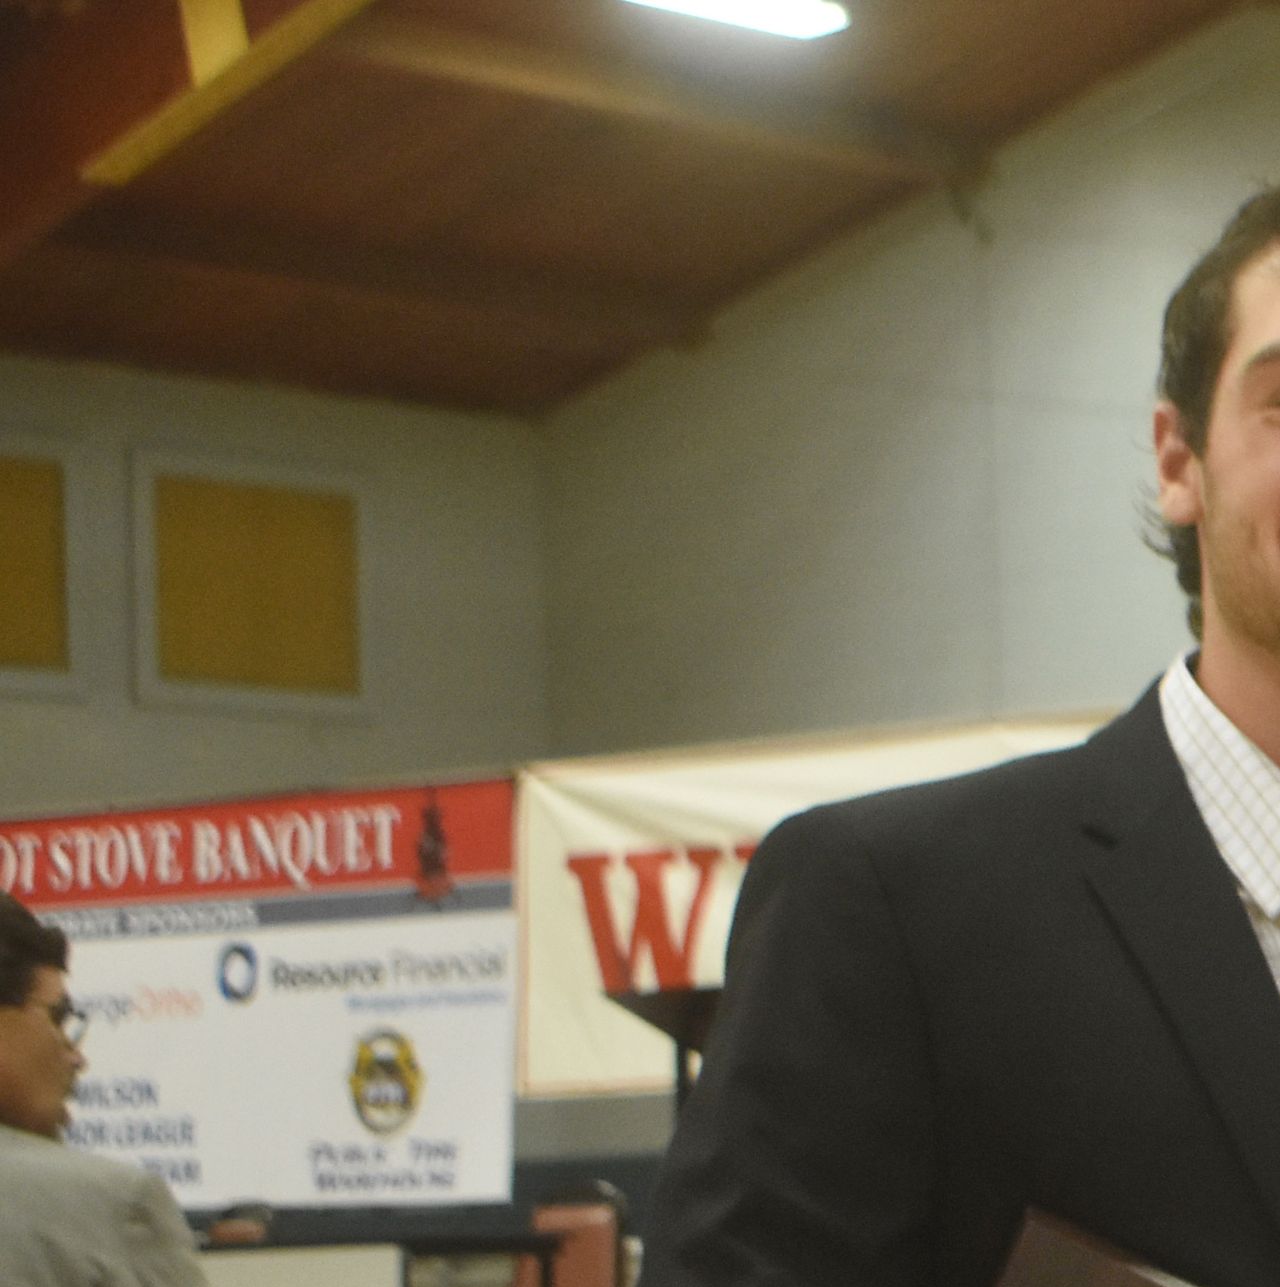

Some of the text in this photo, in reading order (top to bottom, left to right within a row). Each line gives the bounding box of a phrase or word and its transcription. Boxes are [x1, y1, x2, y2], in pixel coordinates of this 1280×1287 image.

[0, 804, 402, 895] OT STOVE BANQUET
[271, 948, 506, 992] Resource Financial
